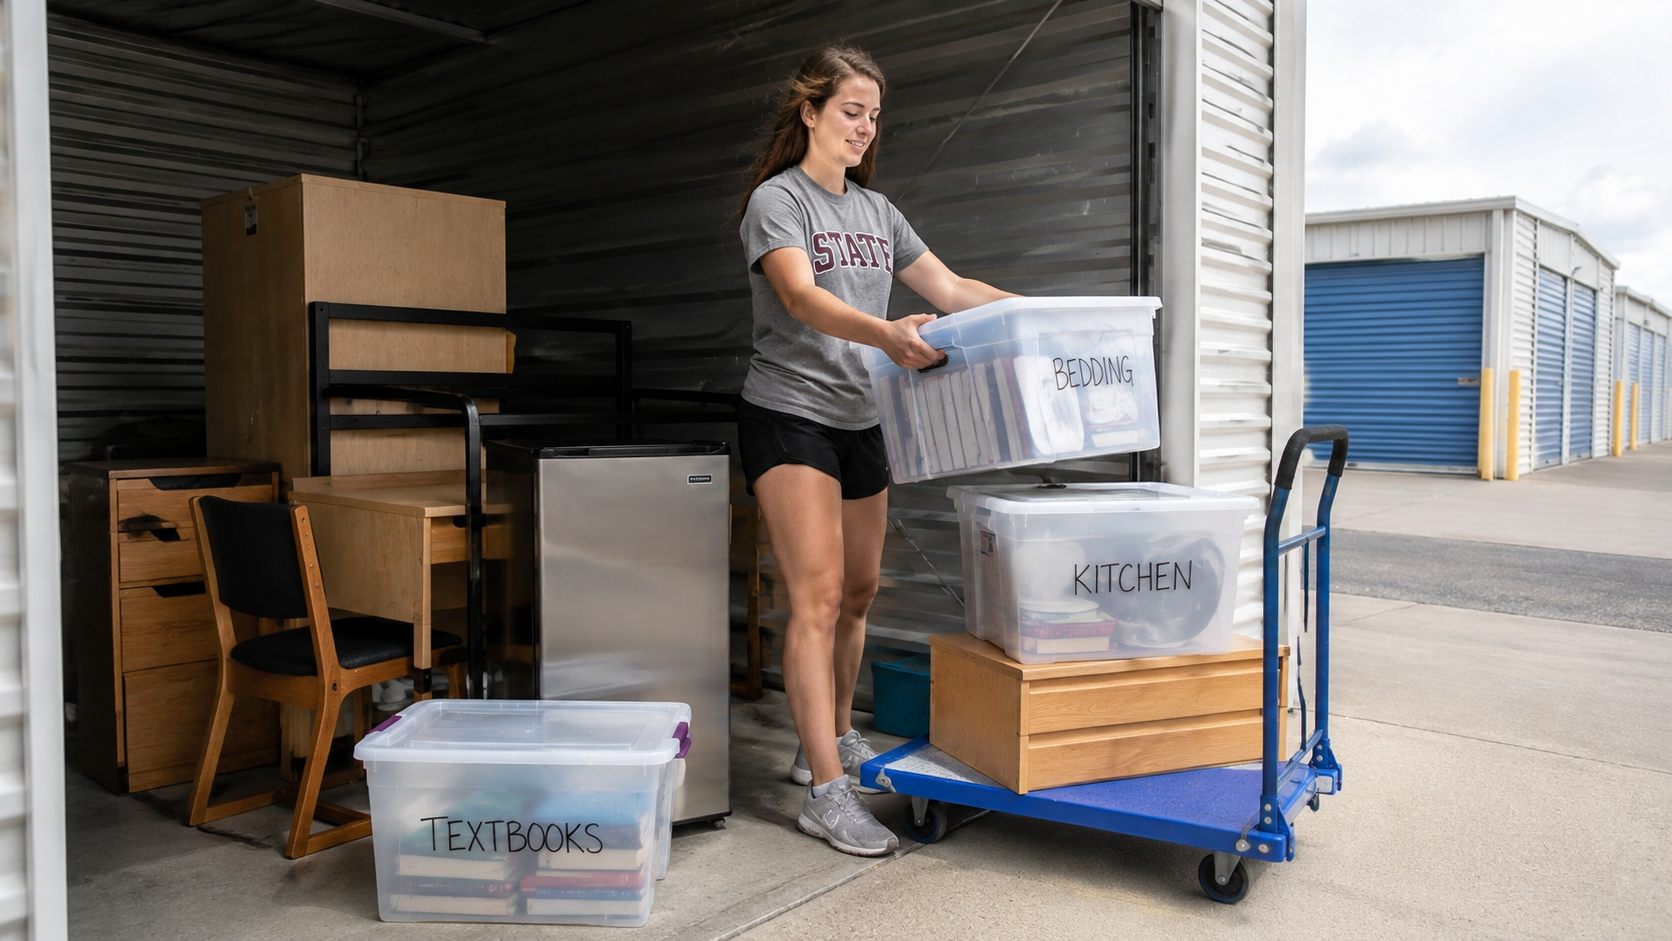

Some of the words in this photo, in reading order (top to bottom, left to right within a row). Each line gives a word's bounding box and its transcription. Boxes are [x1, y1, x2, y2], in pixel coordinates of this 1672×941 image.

[811, 230, 893, 275] STATE
[1052, 355, 1134, 390] BEDDING
[1074, 560, 1193, 595] KITCHEN
[420, 816, 603, 853] TEXTBOOKS
